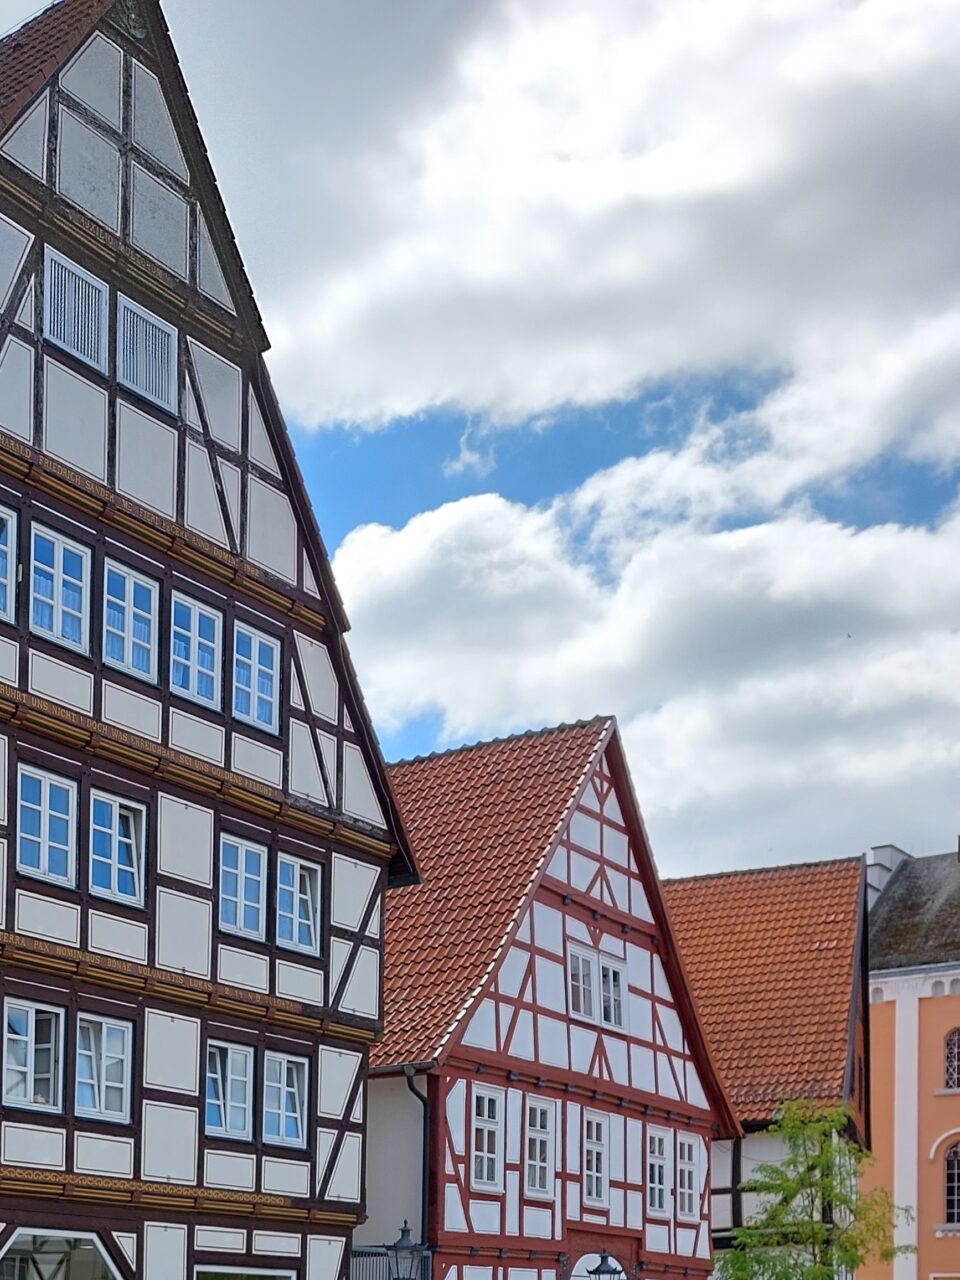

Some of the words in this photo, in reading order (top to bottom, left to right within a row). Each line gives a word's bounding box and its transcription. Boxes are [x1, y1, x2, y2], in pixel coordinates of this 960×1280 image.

[38, 456, 81, 485] FRIEDRICH
[85, 480, 114, 503] SANDER
[31, 697, 48, 711] UNS
[52, 705, 76, 723] NICHT
[86, 719, 108, 735] DOCH
[111, 728, 128, 742] WAS
[130, 736, 175, 760] ERREICHBAR
[179, 754, 193, 767] SEI
[194, 760, 209, 772] UNS
[33, 940, 50, 953] PAX
[56, 947, 101, 965] HOMINIBUS
[107, 958, 131, 973] BONAE
[137, 965, 184, 985] VOLUNTATIS
[189, 979, 213, 992] LUKAS
